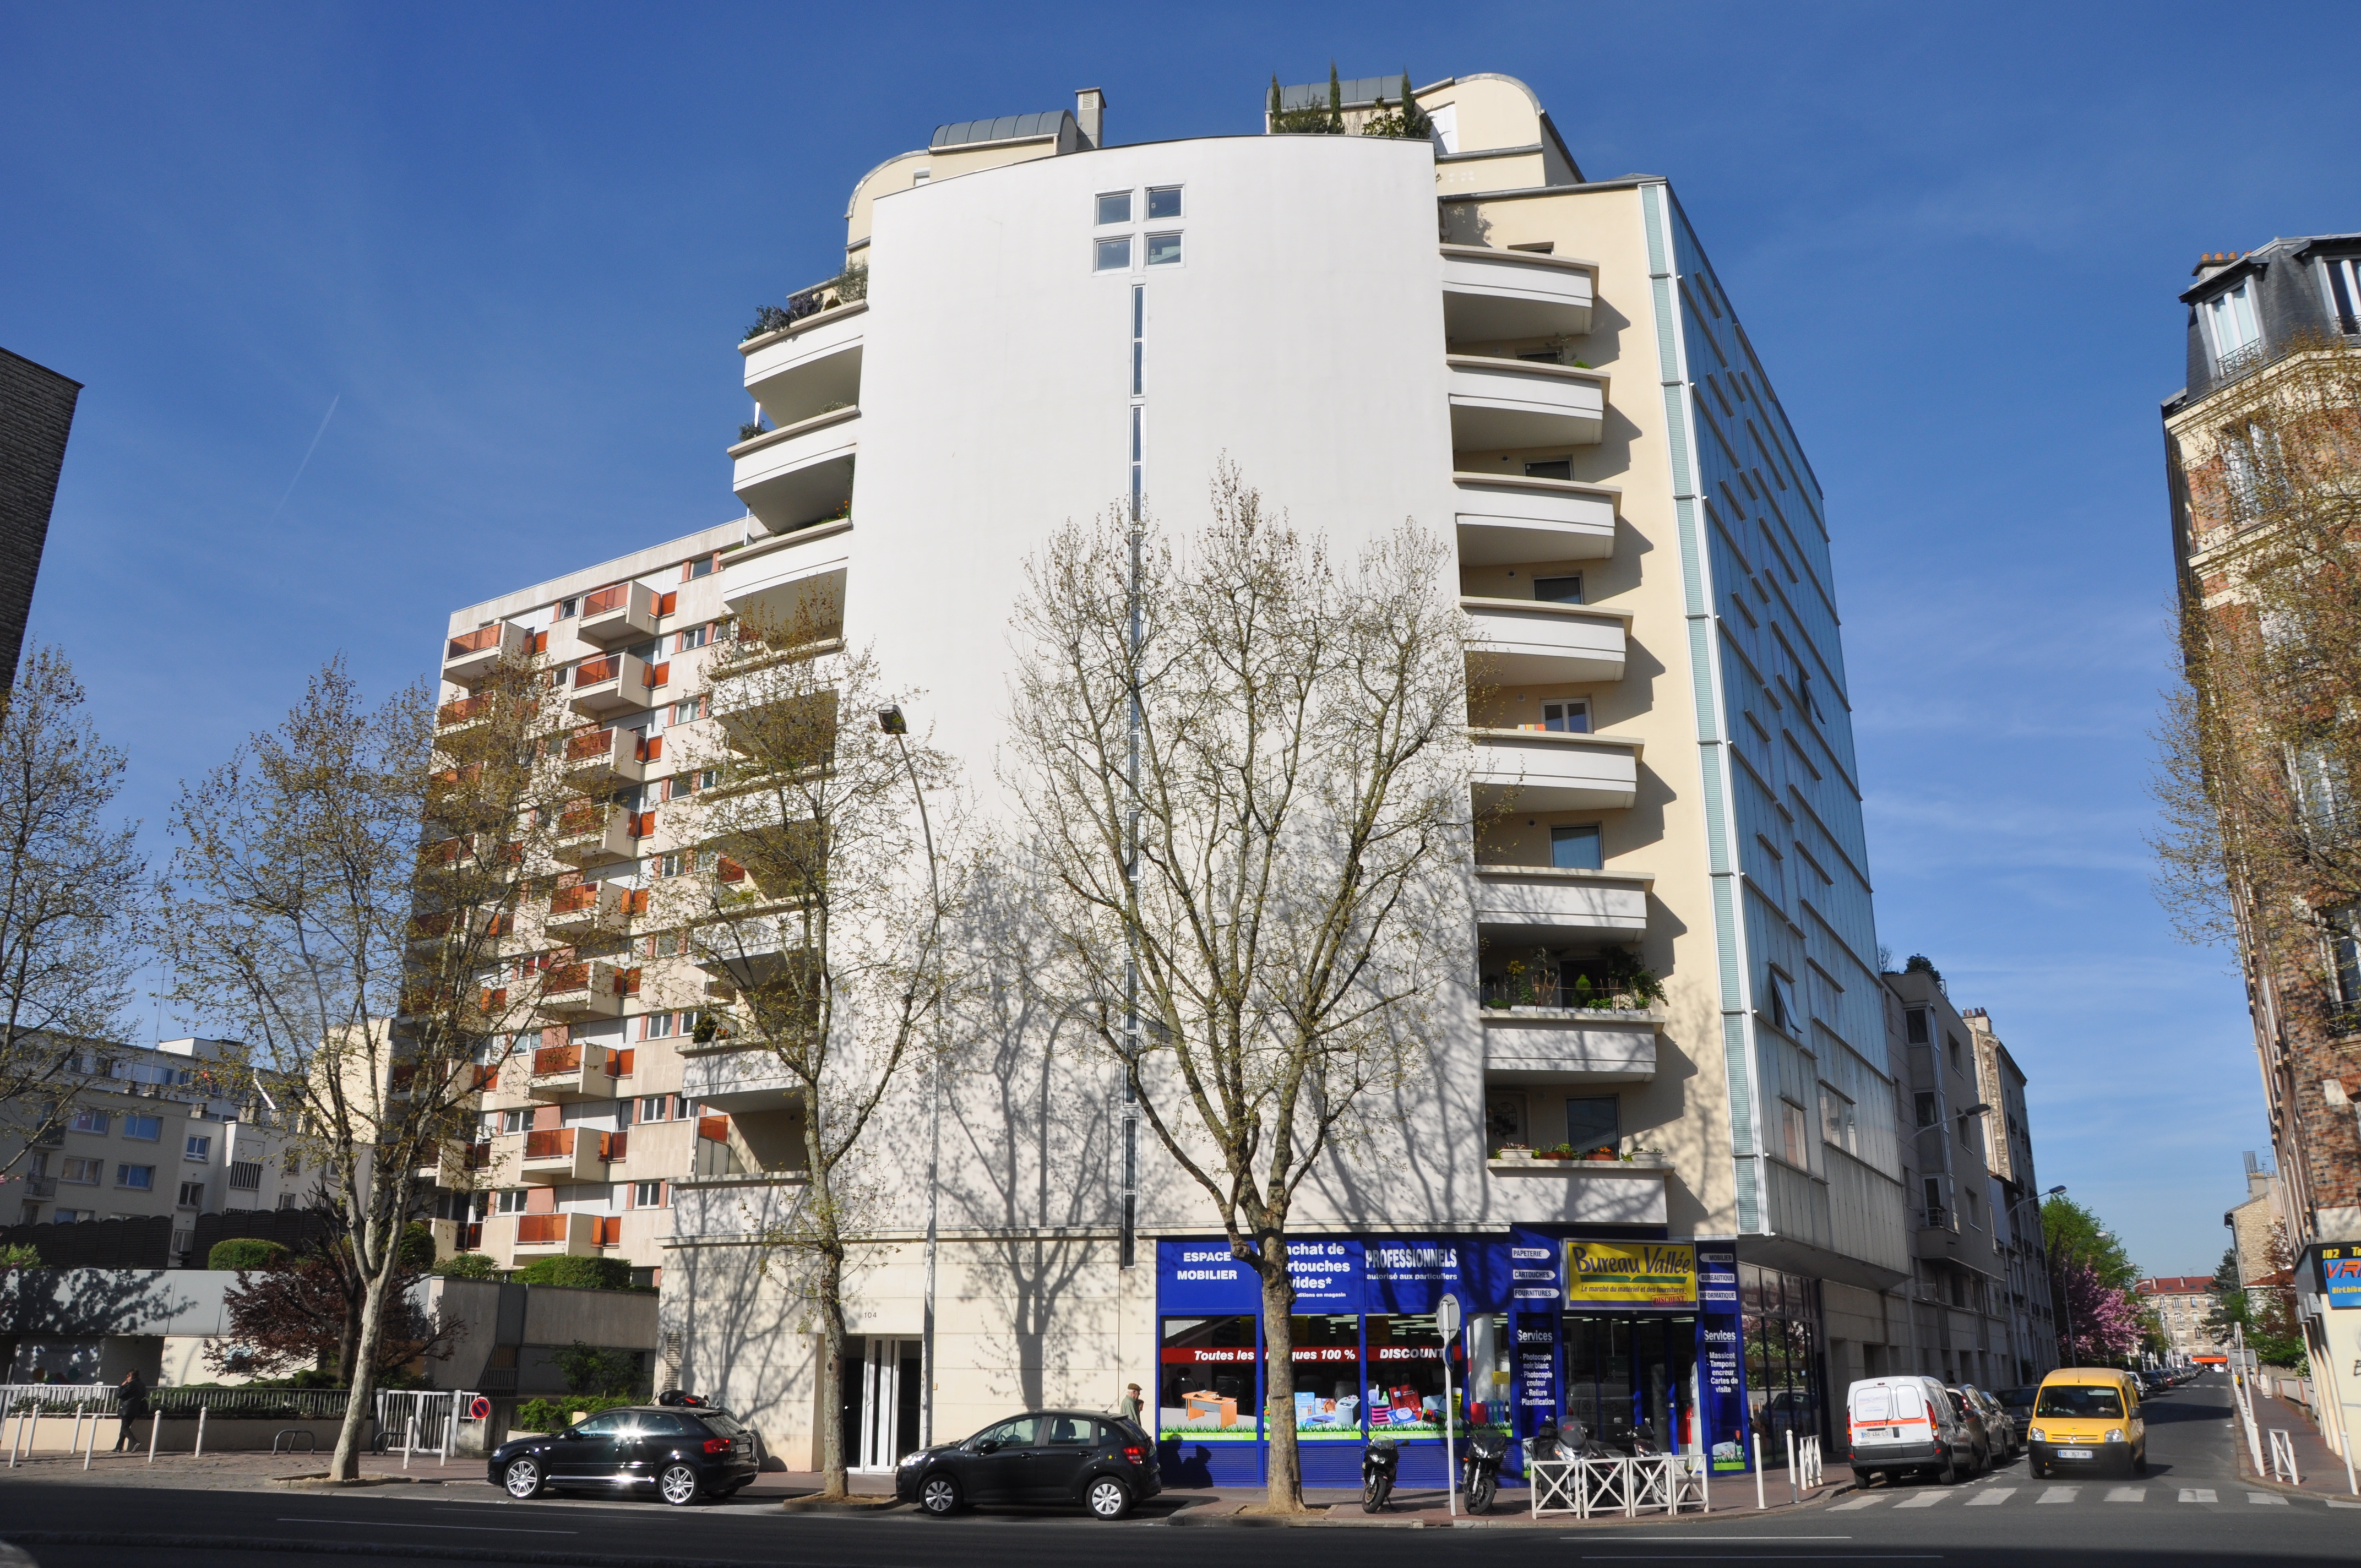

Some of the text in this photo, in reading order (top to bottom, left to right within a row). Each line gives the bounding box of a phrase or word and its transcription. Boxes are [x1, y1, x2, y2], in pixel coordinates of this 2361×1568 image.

[1328, 1243, 1345, 1255] de
[2322, 1249, 2340, 1259] 102
[1183, 1252, 1232, 1262] ESPACE
[1366, 1249, 1457, 1268] PROFESSIONNELS
[1572, 1246, 1691, 1274] Bureau Vallée
[2326, 1260, 2361, 1278] VR
[1177, 1270, 1237, 1280] MOBILIER
[1654, 1295, 1685, 1303] DISCOUNT
[1517, 1329, 1553, 1341] Services
[1704, 1330, 1736, 1341] Services
[1194, 1351, 1234, 1360] Toutes
[1237, 1350, 1254, 1360] les
[1321, 1349, 1342, 1360] 100
[1344, 1349, 1356, 1359] %
[1379, 1348, 1444, 1359] DISCOUNT
[1522, 1353, 1552, 1362] Photocopie
[1710, 1360, 1736, 1369] Tampons
[1524, 1371, 1553, 1379] Photocopie
